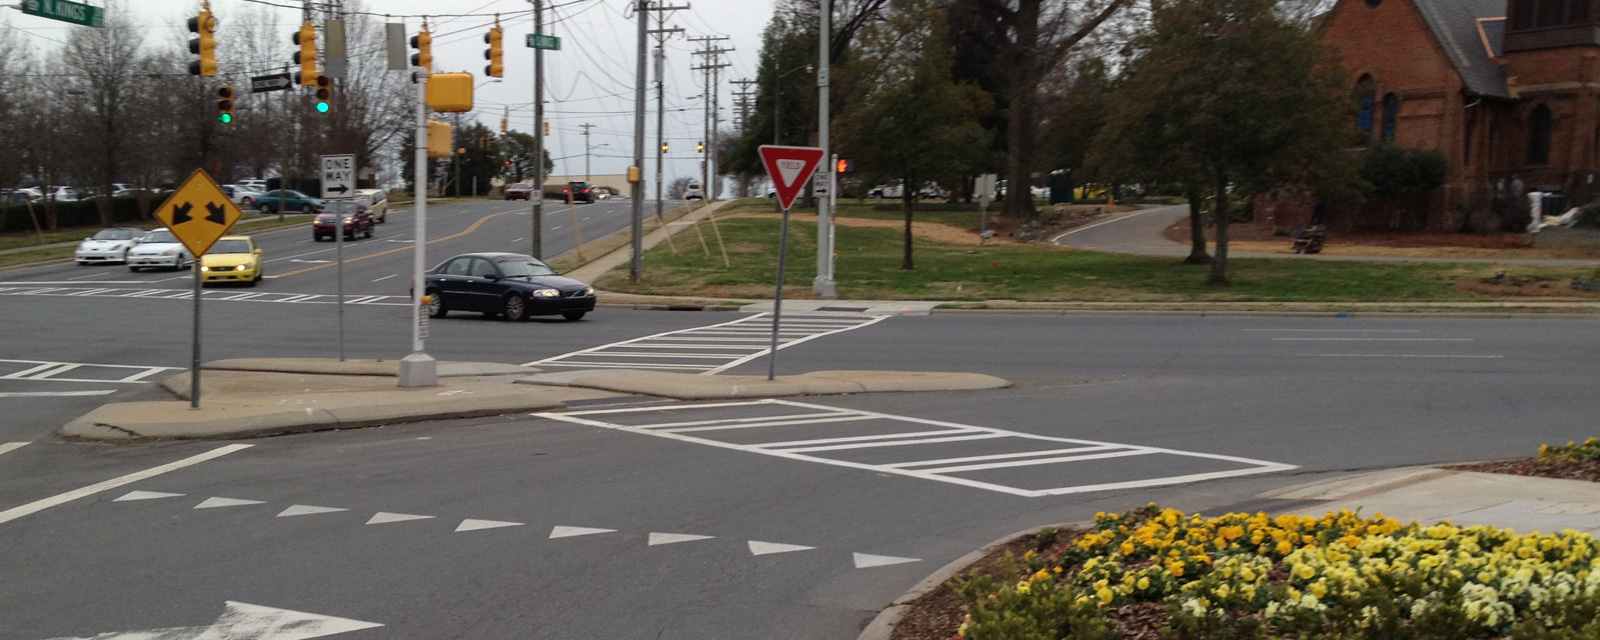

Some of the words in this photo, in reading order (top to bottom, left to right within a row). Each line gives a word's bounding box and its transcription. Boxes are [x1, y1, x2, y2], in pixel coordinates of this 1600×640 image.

[55, 1, 86, 20] KINGS
[326, 159, 350, 169] ONE
[781, 161, 802, 170] YIELD
[325, 170, 351, 181] WAY
